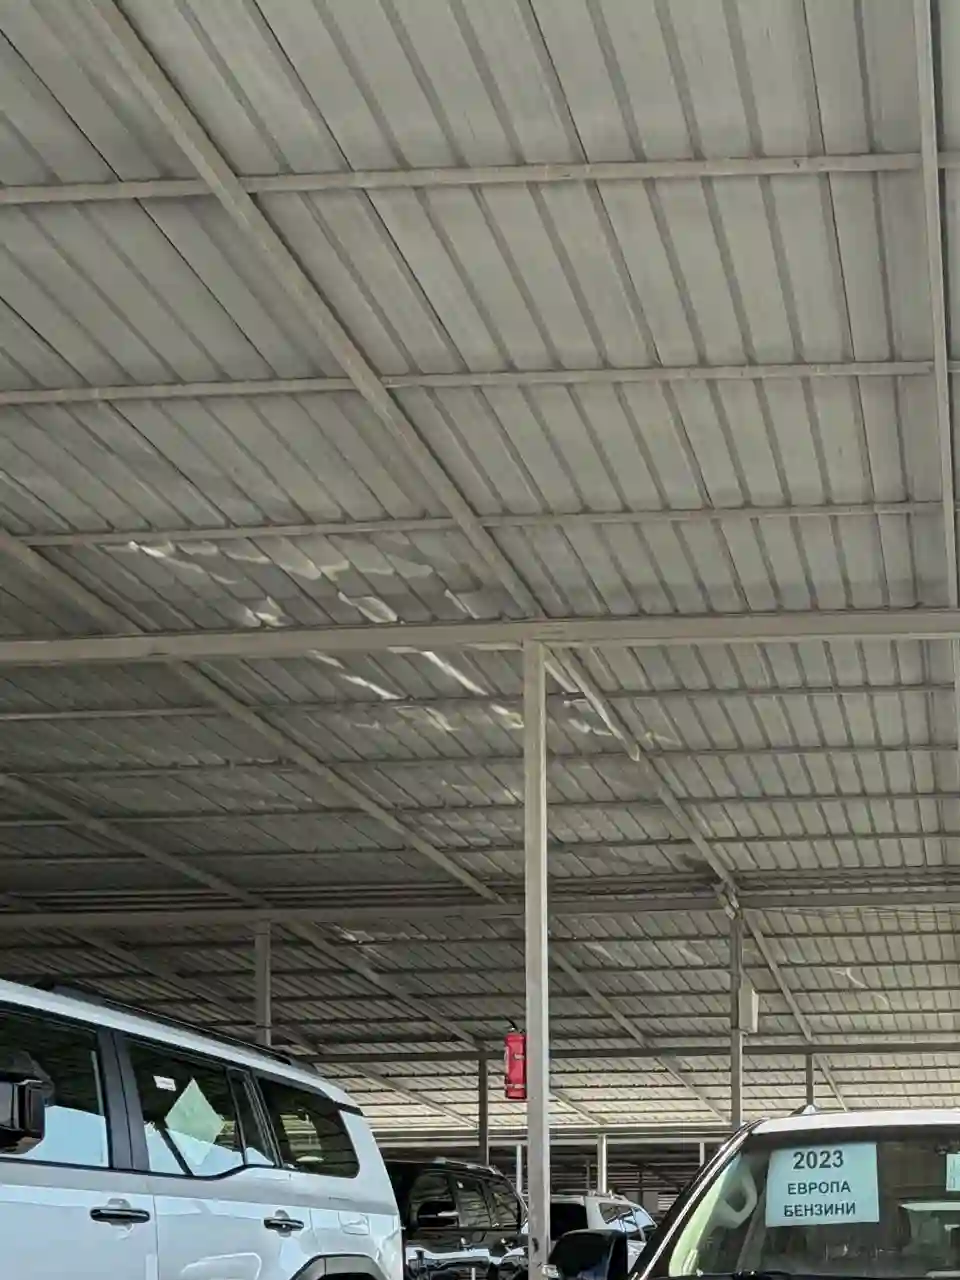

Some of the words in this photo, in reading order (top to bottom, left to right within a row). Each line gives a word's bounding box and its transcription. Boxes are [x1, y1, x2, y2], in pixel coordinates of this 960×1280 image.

[792, 1150, 844, 1169] 2023
[787, 1180, 852, 1195] ЕВРОПА
[783, 1202, 856, 1217] БЕНЗИНИ
